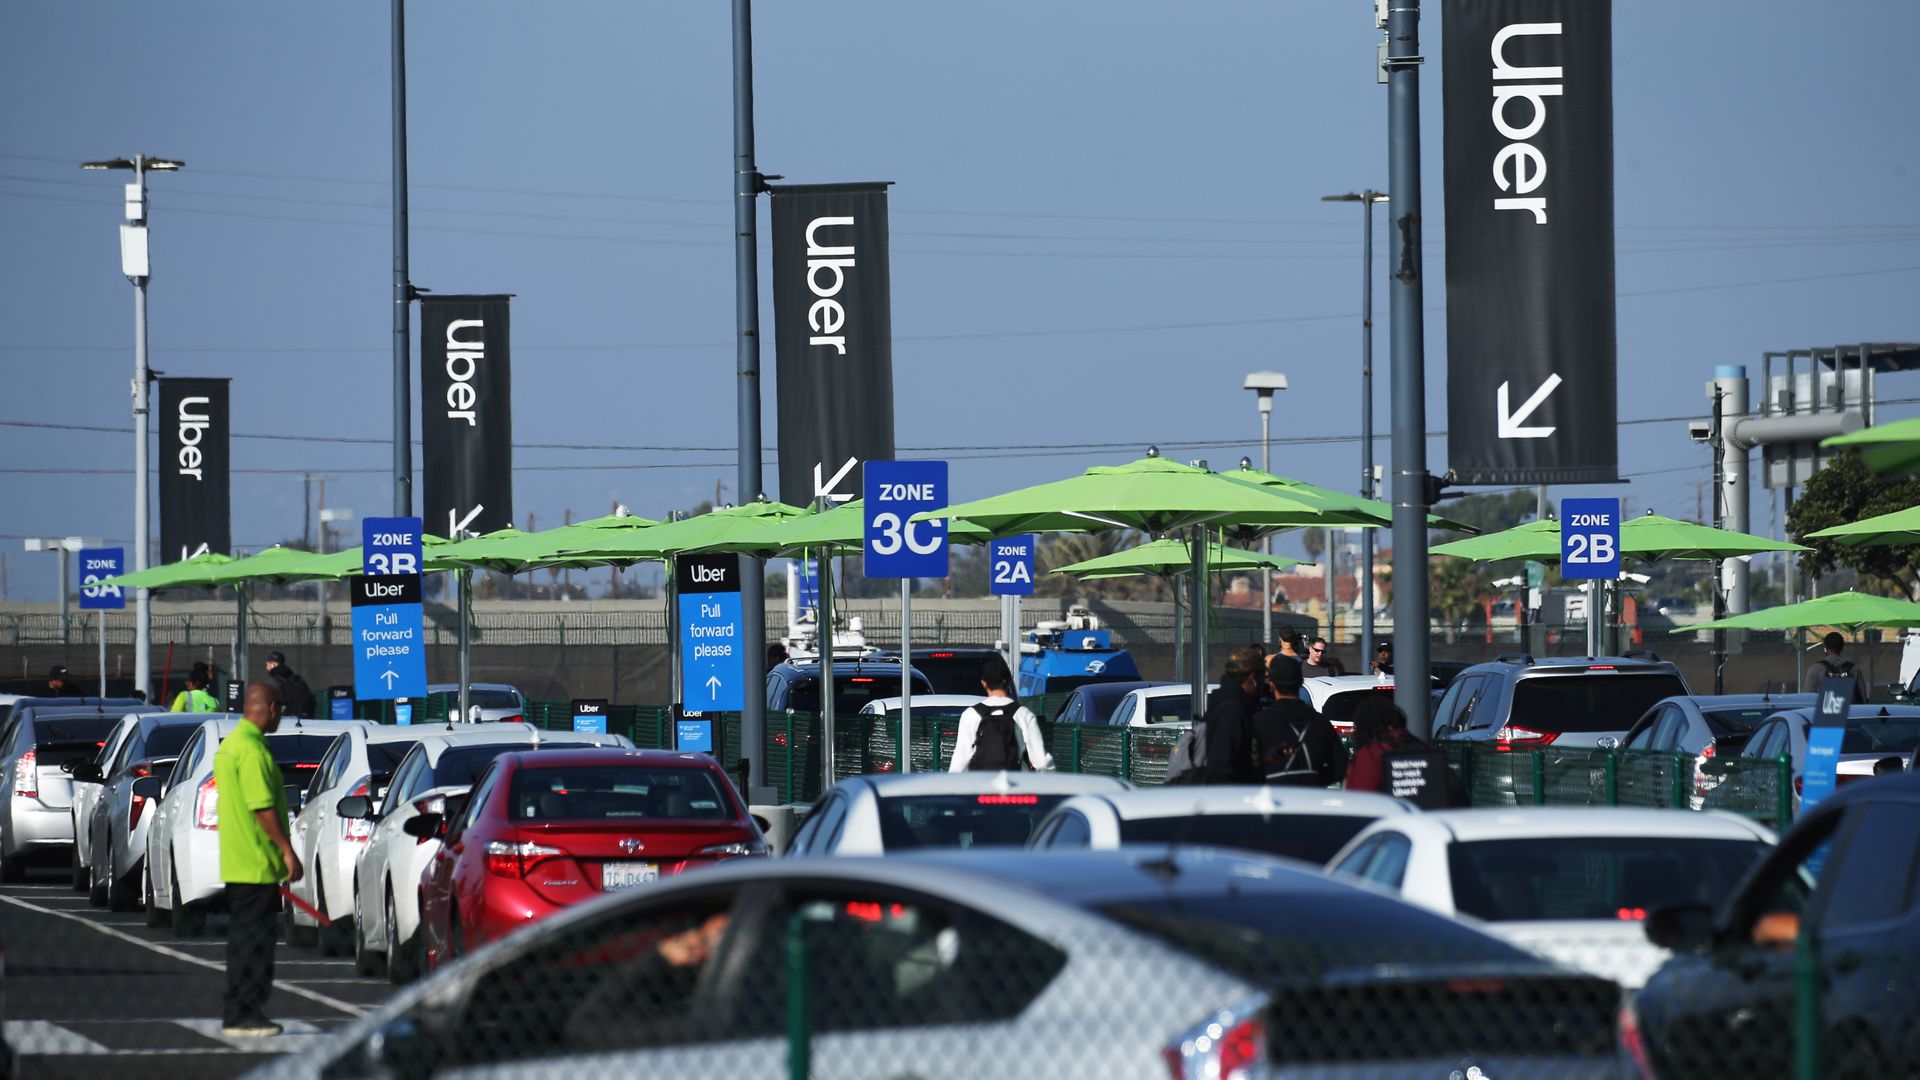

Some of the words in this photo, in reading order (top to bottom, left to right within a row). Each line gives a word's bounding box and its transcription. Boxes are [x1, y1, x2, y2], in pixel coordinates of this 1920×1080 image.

[1491, 22, 1563, 225] Uber
[805, 216, 856, 355] Uber
[446, 319, 485, 427] Uber
[178, 396, 210, 481] Uber
[879, 483, 935, 501] ZONE
[1571, 514, 1610, 527] ZONE
[372, 533, 413, 546] ZONE
[871, 512, 943, 555] 3C
[997, 546, 1027, 556] ZONE
[1567, 534, 1615, 564] 2B
[86, 559, 117, 570] ZONE
[690, 564, 726, 583] Uber
[994, 561, 1031, 584] 2A
[83, 574, 121, 598] 3A
[364, 582, 405, 598] Uber
[375, 613, 398, 625] Pull
[701, 604, 721, 618] Pull
[361, 628, 413, 641] forward
[689, 623, 734, 638] forward
[366, 645, 410, 660] please
[694, 642, 732, 661] please
[579, 704, 599, 713] Uber
[1822, 690, 1845, 715] Uber
